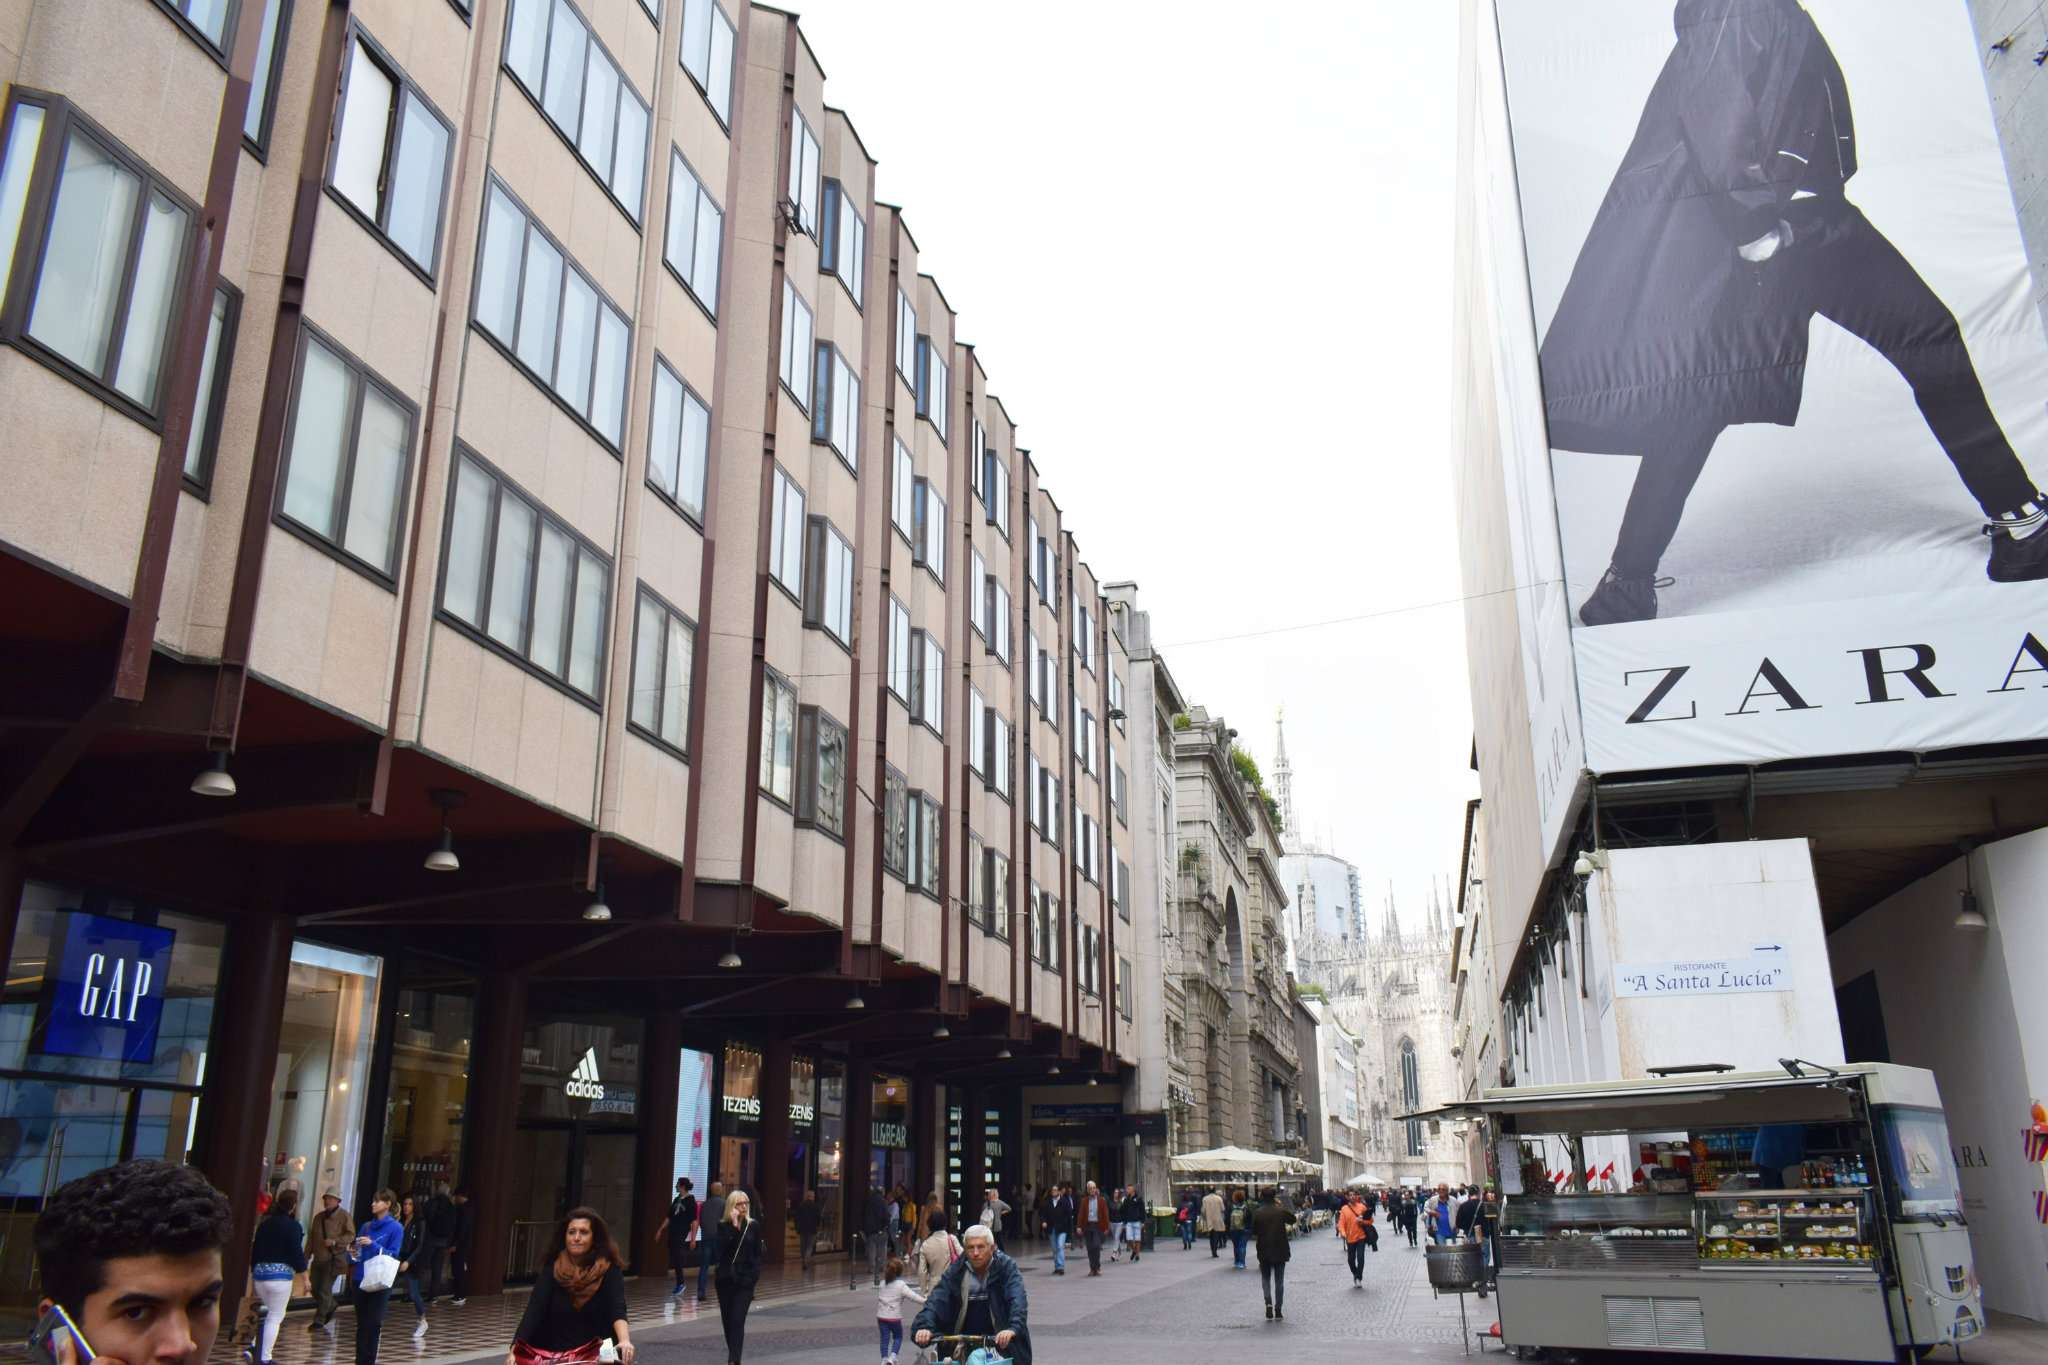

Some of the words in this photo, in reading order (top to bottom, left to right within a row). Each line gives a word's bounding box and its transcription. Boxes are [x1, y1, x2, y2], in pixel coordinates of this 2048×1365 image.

[1624, 631, 2048, 725] ZARA
[1541, 703, 1570, 824] ZARA
[1673, 962, 1728, 972] RISTORANTE
[80, 953, 152, 1021] GAP
[1655, 974, 1712, 991] Santa
[566, 1079, 604, 1099] adidas
[723, 1095, 760, 1115] TEZENIS
